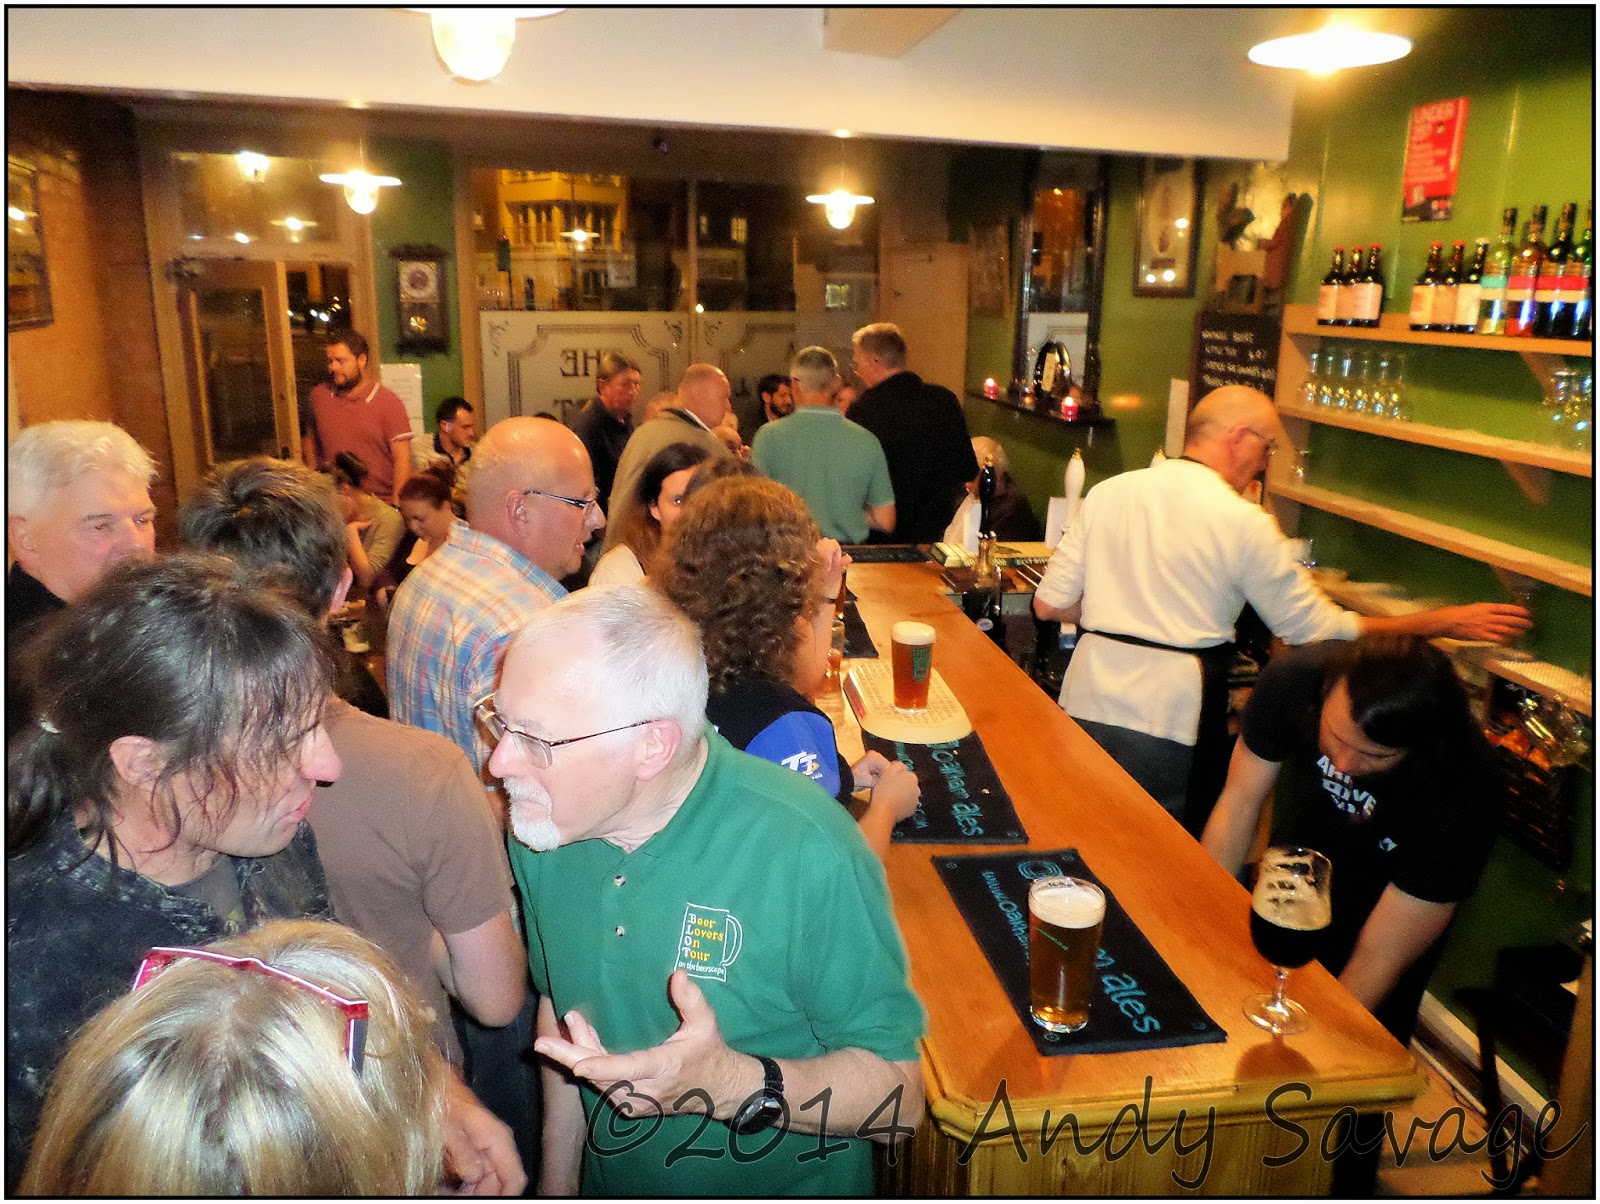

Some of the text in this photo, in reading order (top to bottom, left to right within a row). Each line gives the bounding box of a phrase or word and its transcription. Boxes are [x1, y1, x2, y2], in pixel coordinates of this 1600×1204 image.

[952, 802, 985, 836] ales
[687, 912, 717, 929] Beer
[685, 924, 724, 941] Lovers
[684, 935, 700, 949] On
[682, 946, 711, 962] Tour
[1101, 973, 1162, 1034] ales
